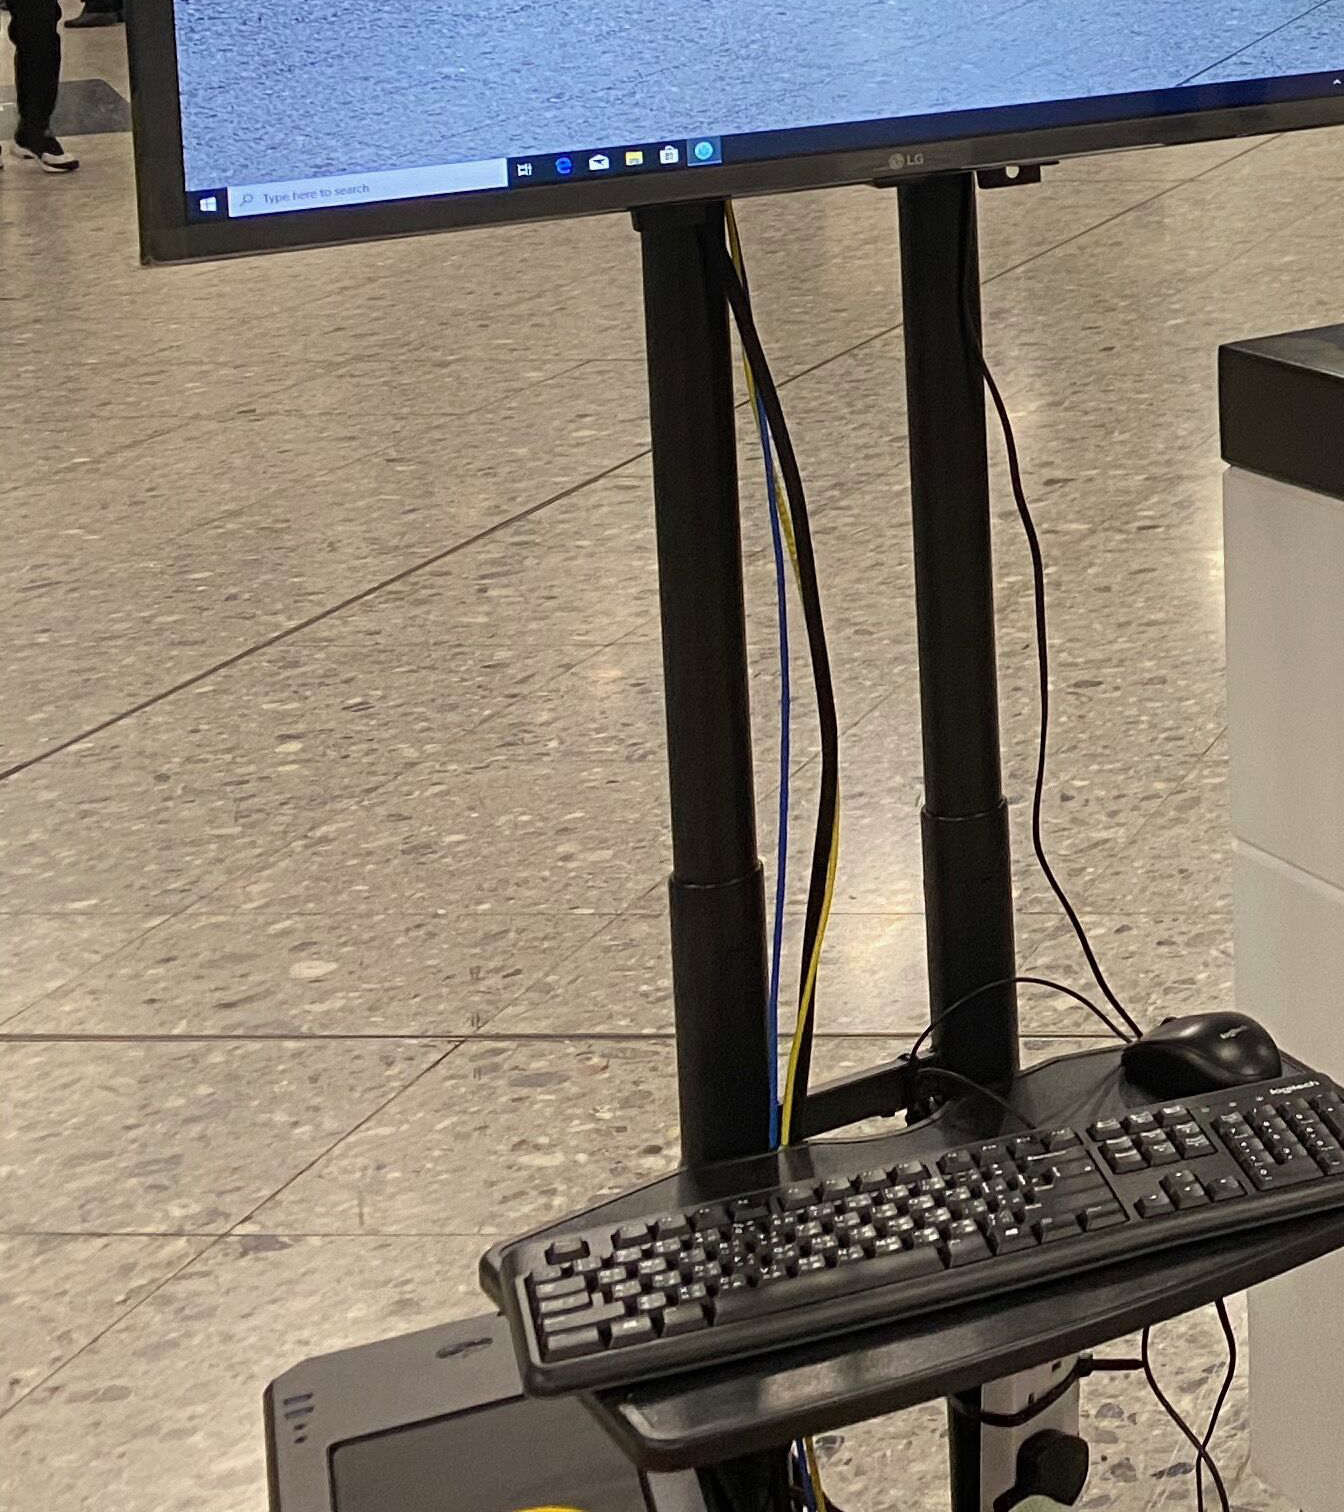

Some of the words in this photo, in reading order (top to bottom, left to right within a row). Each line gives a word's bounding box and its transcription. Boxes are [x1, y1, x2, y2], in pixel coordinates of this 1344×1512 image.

[907, 152, 924, 166] LG
[263, 190, 289, 206] Type
[291, 188, 317, 202] here
[319, 187, 331, 199] to
[334, 181, 369, 197] search
[1270, 1079, 1320, 1095] logitech
